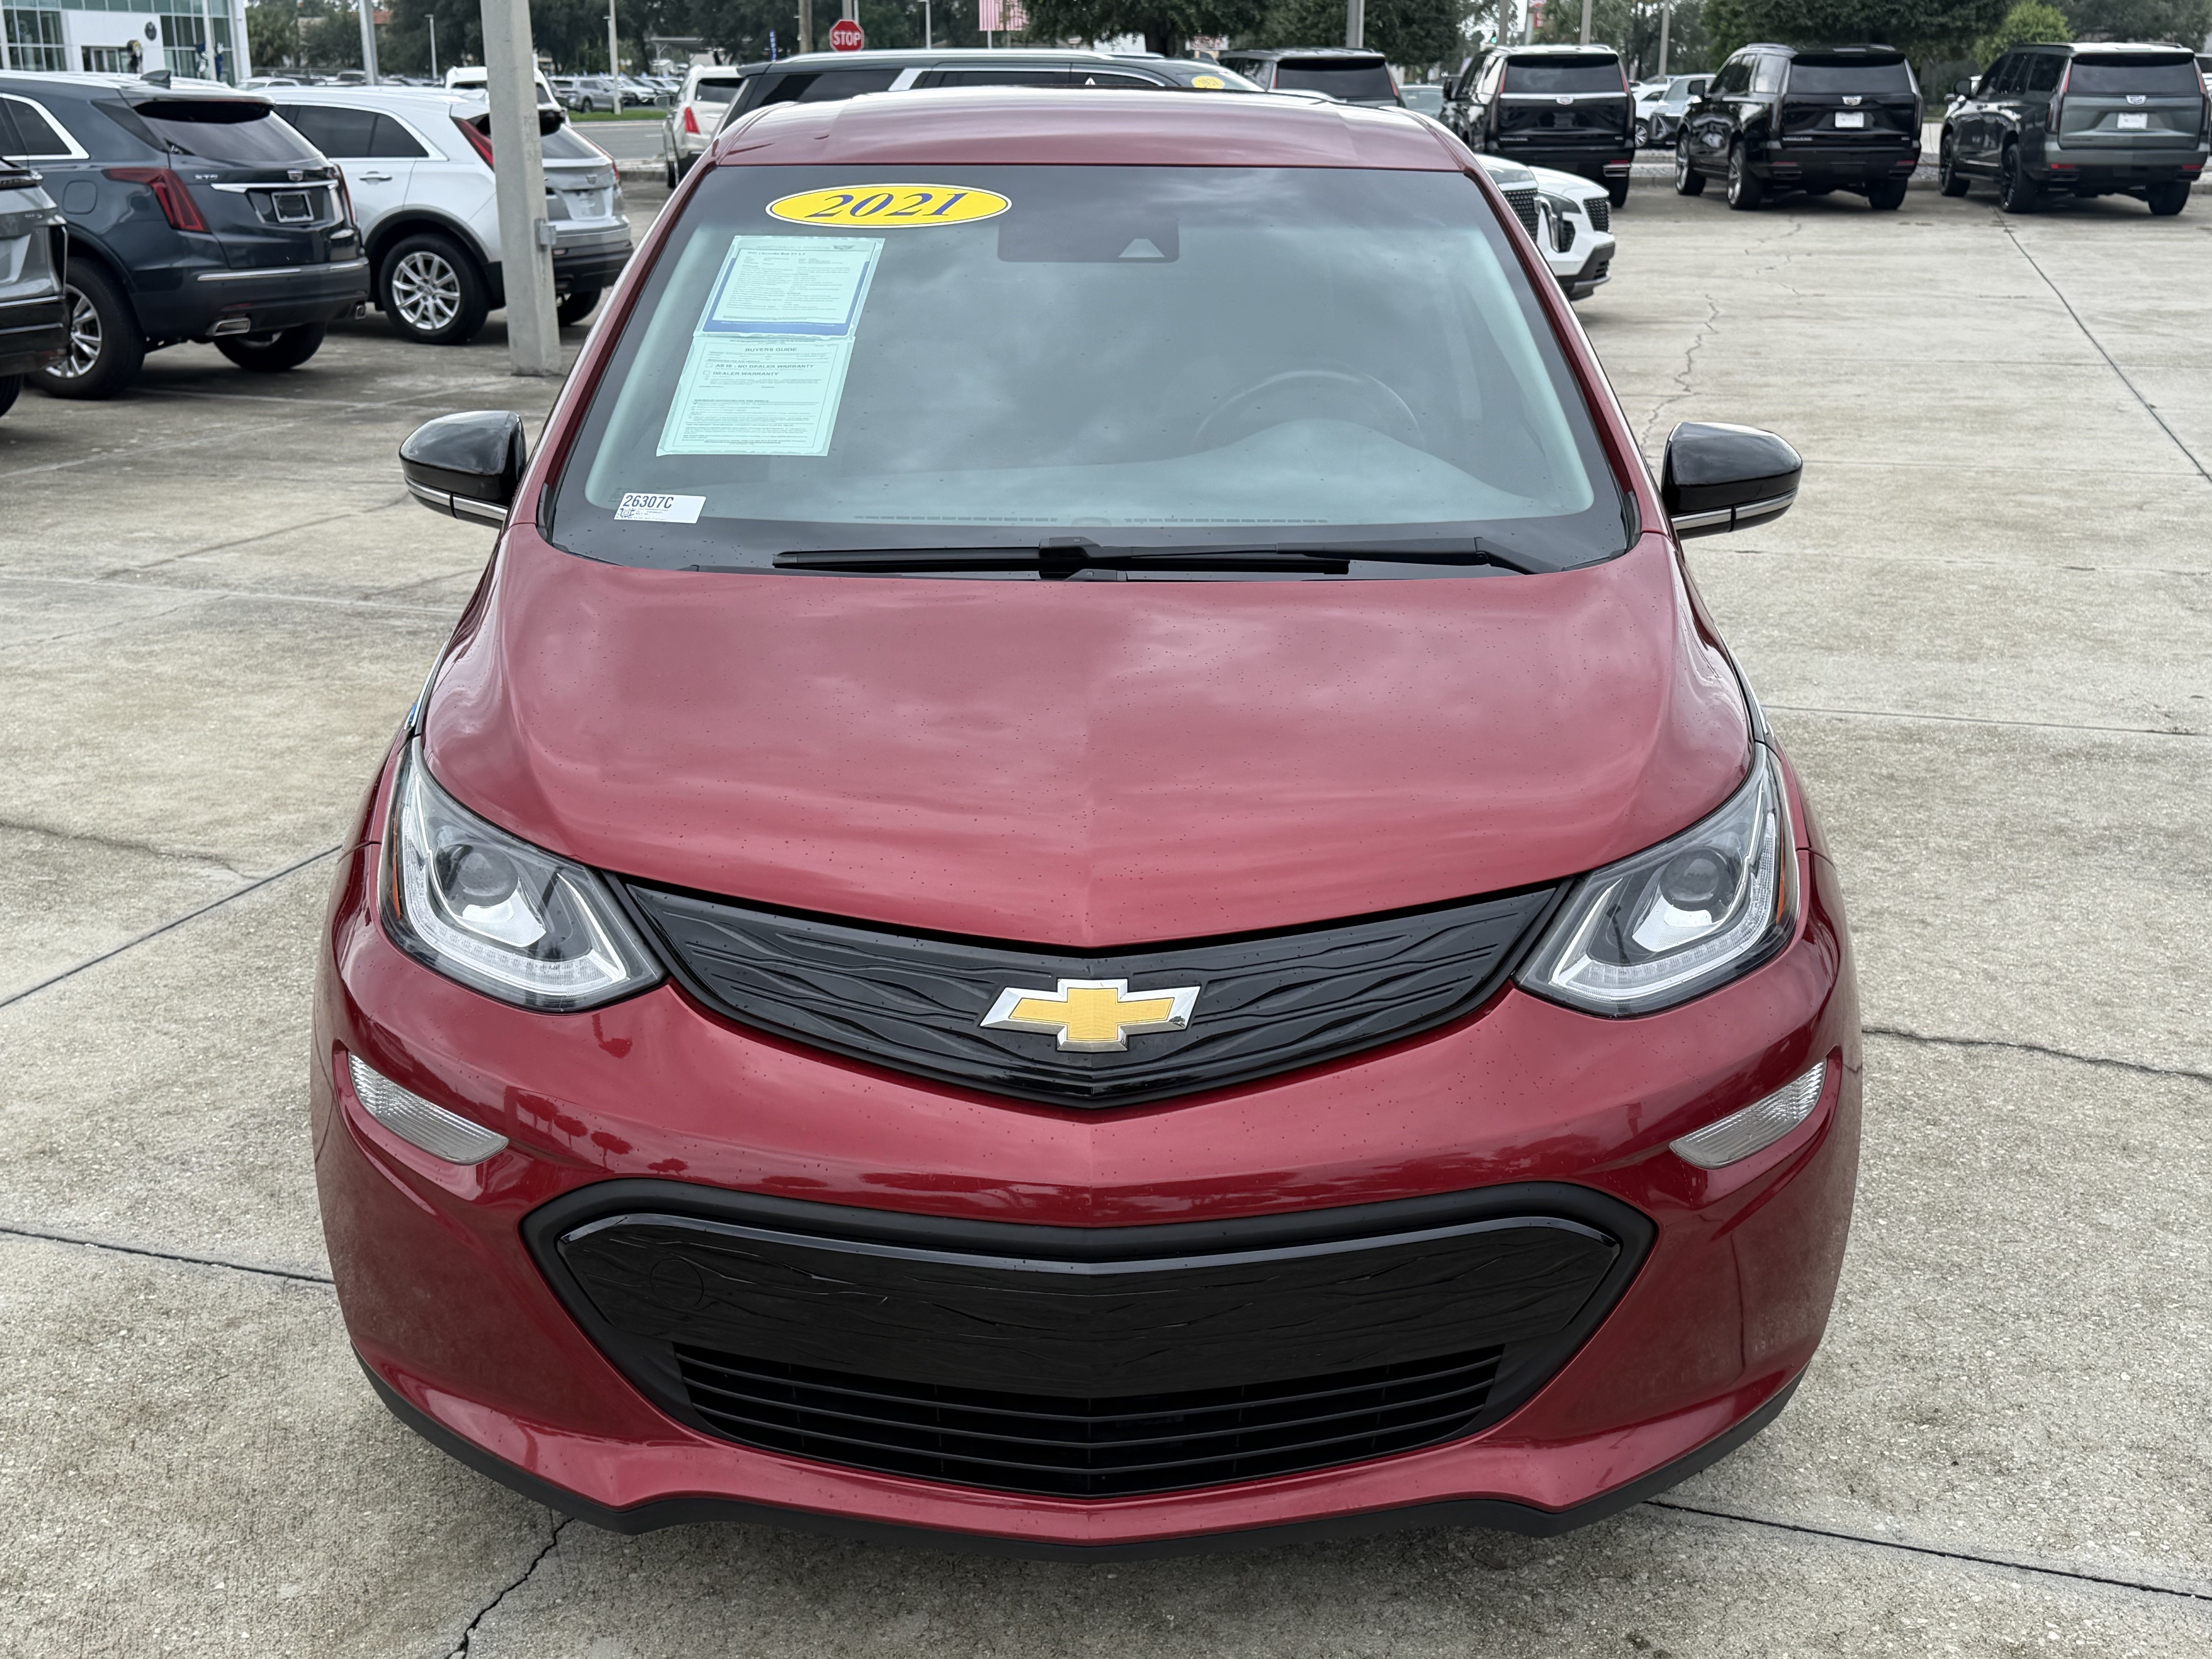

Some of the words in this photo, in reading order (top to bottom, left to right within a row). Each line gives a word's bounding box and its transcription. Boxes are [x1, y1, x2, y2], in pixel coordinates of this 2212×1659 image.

[833, 31, 861, 46] STOP
[804, 192, 967, 218] 2021
[623, 495, 674, 508] 26307C
